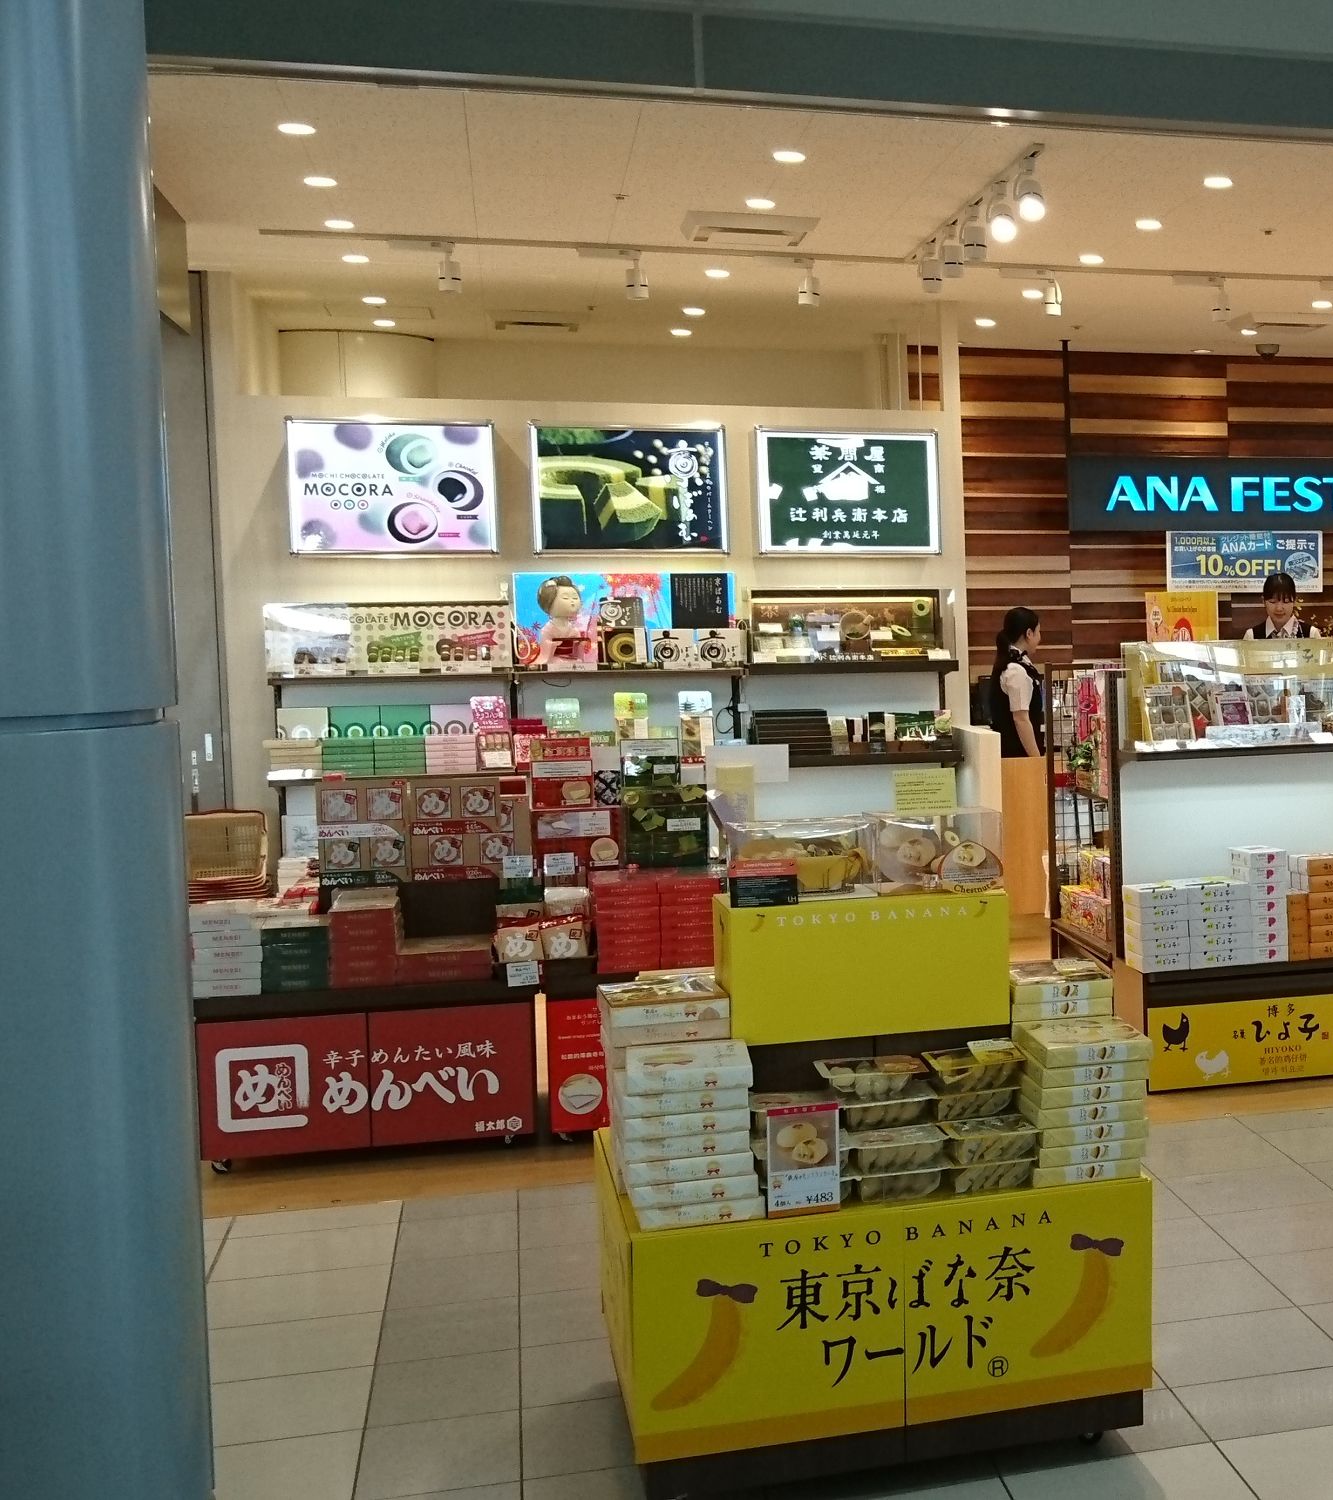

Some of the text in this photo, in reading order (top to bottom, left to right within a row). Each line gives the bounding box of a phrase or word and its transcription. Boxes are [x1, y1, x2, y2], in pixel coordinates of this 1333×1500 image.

[304, 482, 394, 497] MOCORA
[1106, 475, 1219, 512] ANA
[1221, 539, 1272, 554] ANAカード
[1276, 539, 1316, 551] ご提示で
[393, 611, 497, 627] MOCORA
[953, 882, 993, 895] Chestnut
[776, 905, 968, 928] TOKYO BANANA
[1267, 1003, 1295, 1018] 博多
[1251, 1013, 1320, 1043] ひよ子
[322, 1039, 498, 1067] 辛子めんたい風味
[1264, 1044, 1302, 1054] HIYOKO
[274, 1062, 294, 1112] めんべい
[321, 1066, 500, 1115] めんべい
[475, 1117, 506, 1133] 福太郎
[806, 1191, 834, 1205] ¥483
[759, 1209, 1053, 1259] TOKYO BANANA
[776, 1246, 1037, 1332] 東京ばな奈
[821, 1313, 994, 1389] ワールド
